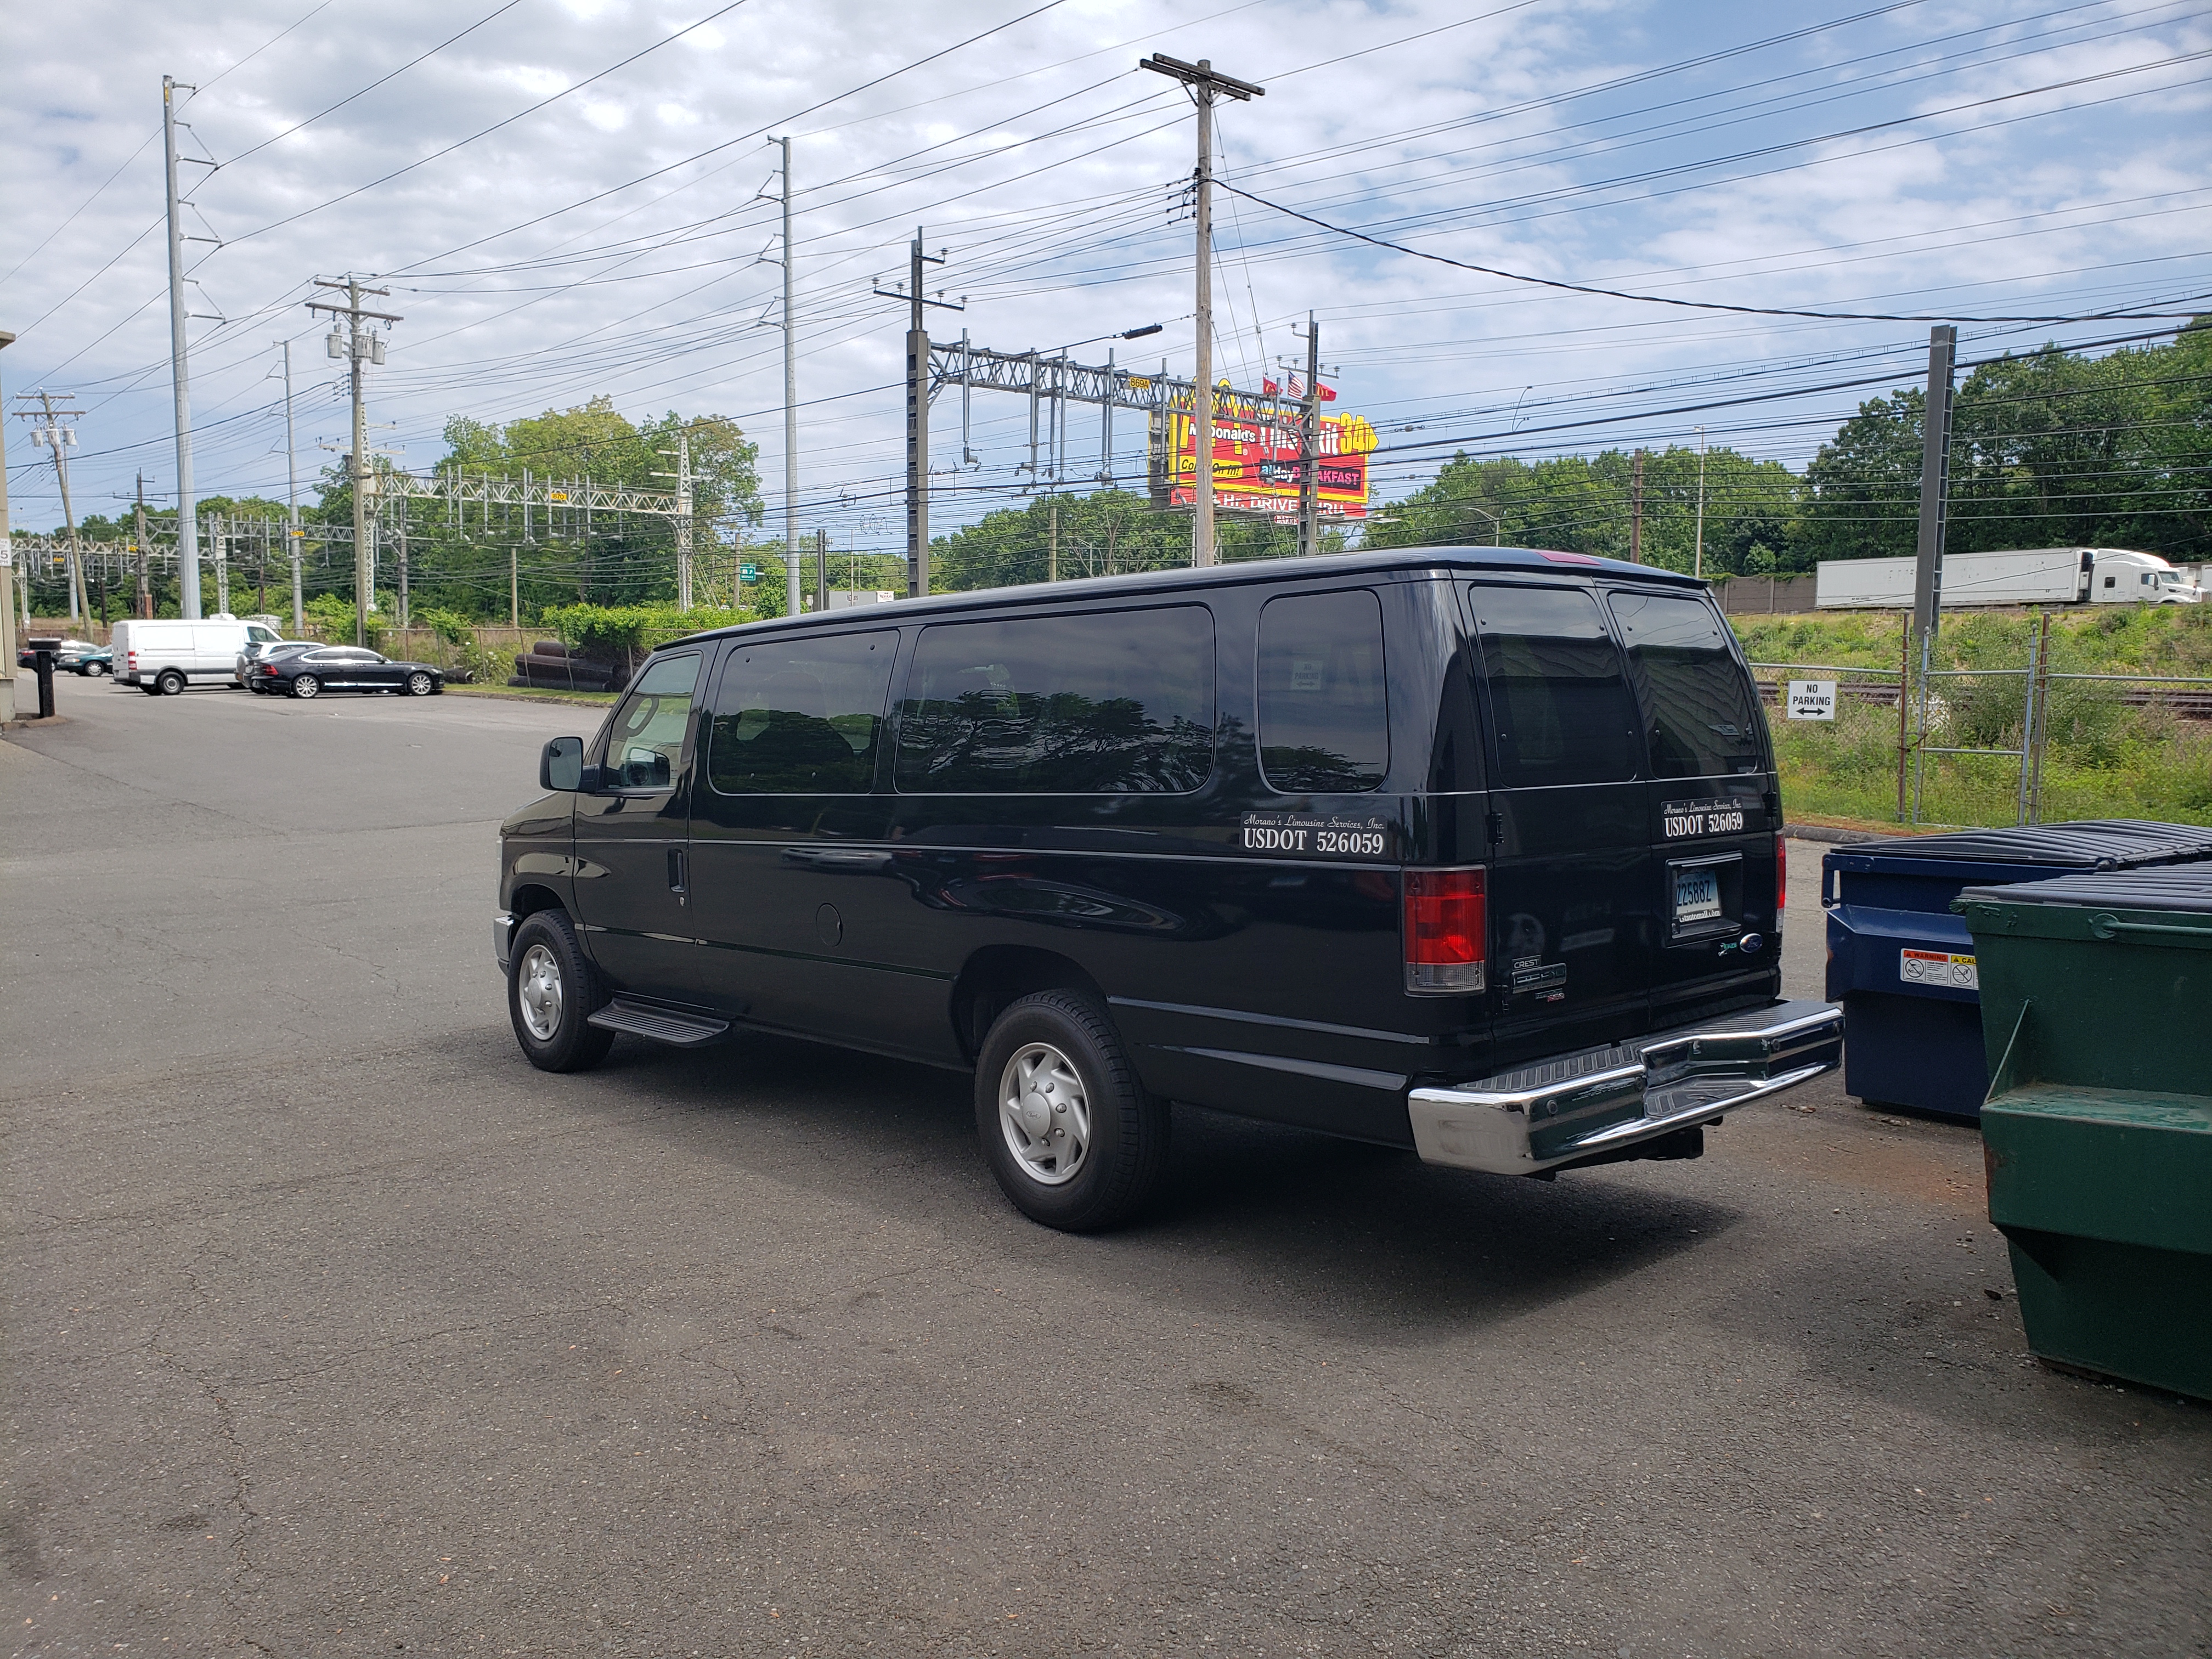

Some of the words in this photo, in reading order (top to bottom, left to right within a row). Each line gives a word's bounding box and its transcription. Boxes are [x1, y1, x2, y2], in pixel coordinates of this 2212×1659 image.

[1130, 378, 1149, 389] 869A
[1340, 412, 1365, 457] 34
[1292, 466, 1359, 486] BAKFAST
[1223, 494, 1245, 507] Hr.
[1250, 496, 1298, 511] DRIVE
[0, 550, 9, 560] 5
[1806, 684, 1818, 693] NO
[1792, 696, 1831, 706] PARKING
[1663, 802, 1688, 815] Morano's
[1688, 801, 1712, 813] Limousine
[1244, 814, 1282, 826] Morano's
[1284, 814, 1325, 827] Limousine
[1327, 816, 1363, 830] Services,
[1365, 817, 1385, 830] Inc.
[1664, 814, 1703, 838] USDOT
[1708, 811, 1744, 833] 526059
[1243, 827, 1307, 851] USDOT
[1316, 831, 1384, 854] 526059
[1514, 958, 1539, 969] CREST
